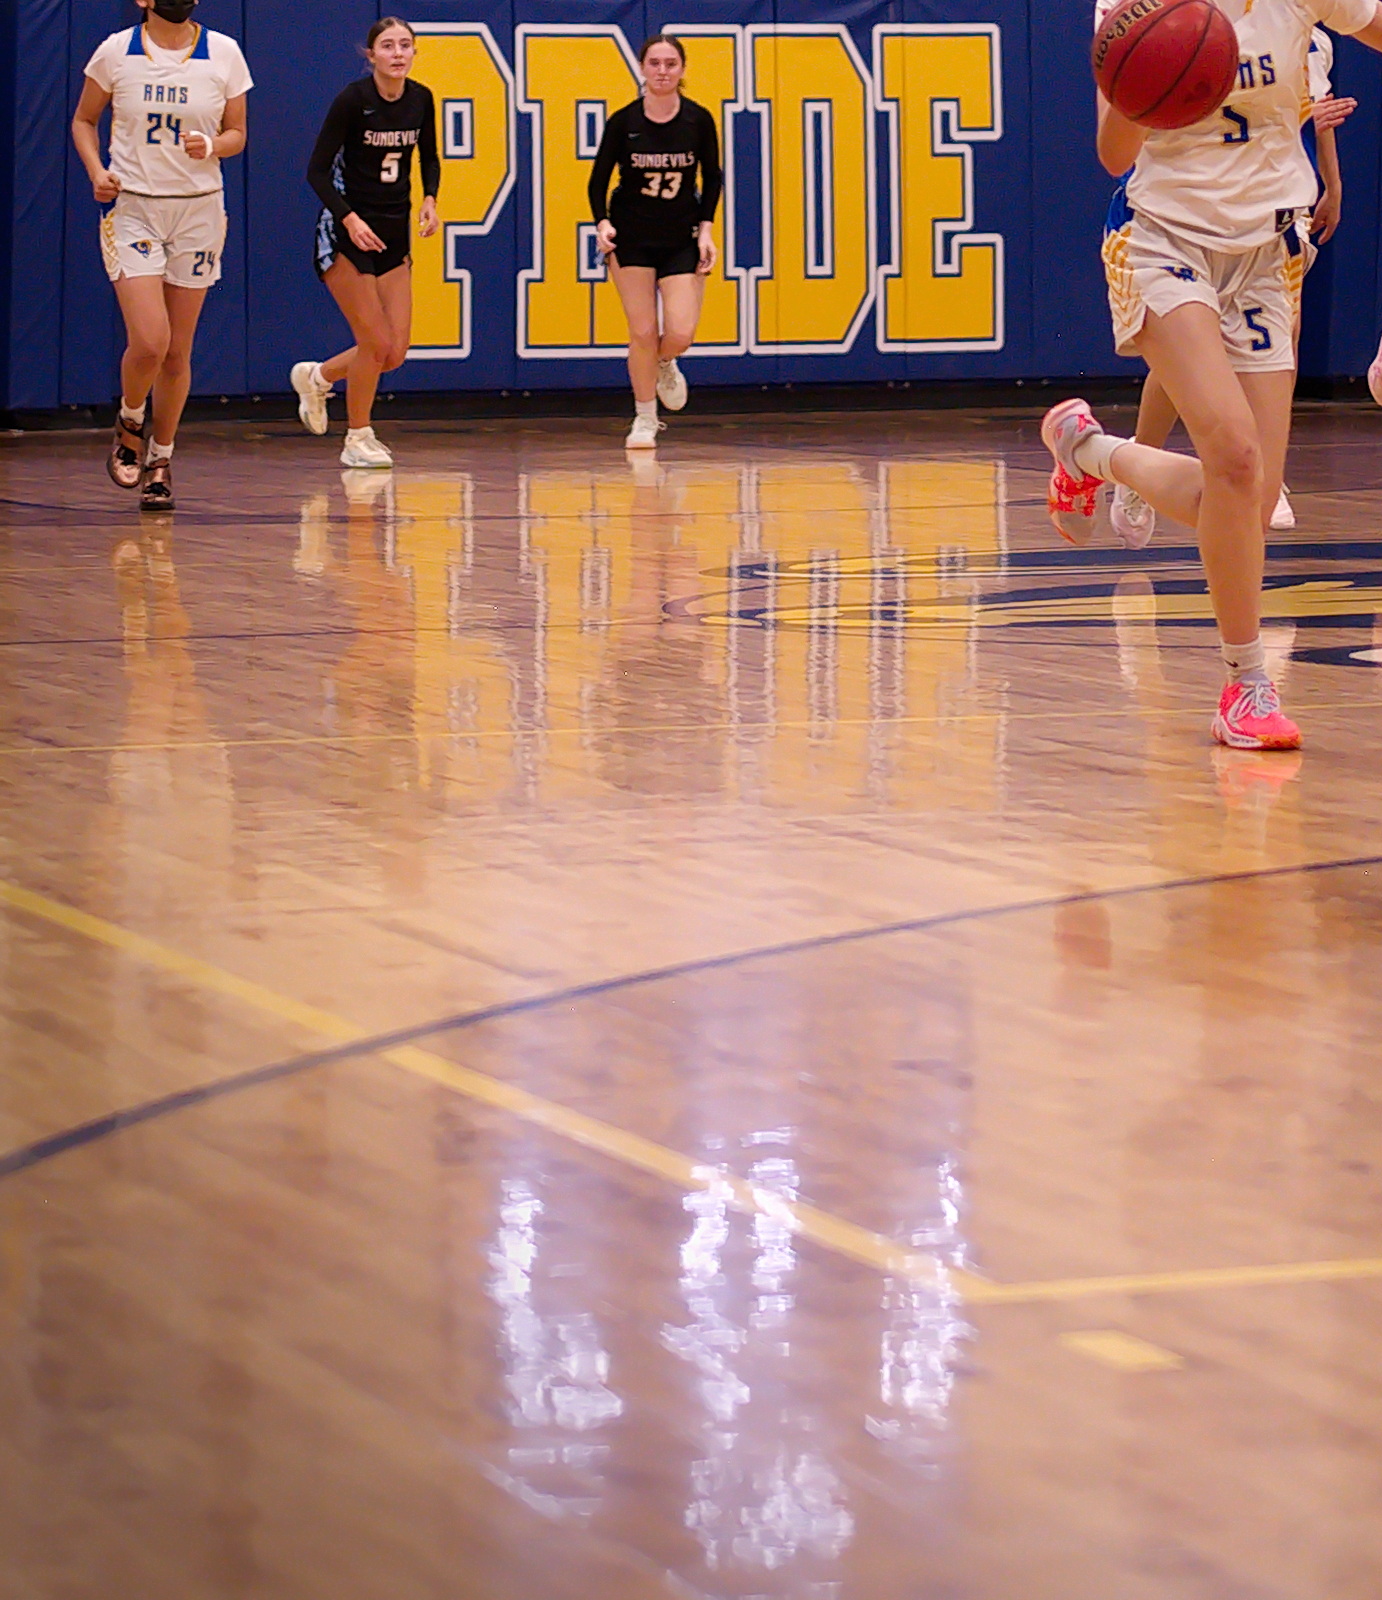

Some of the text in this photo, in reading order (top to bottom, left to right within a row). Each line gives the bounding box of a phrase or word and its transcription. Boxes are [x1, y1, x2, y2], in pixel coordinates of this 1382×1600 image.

[143, 83, 189, 104] RAMS
[146, 112, 182, 146] 24
[380, 152, 403, 183] 5
[630, 152, 695, 169] SUNDEVILS
[641, 171, 684, 200] 33
[191, 251, 216, 277] 24
[1243, 307, 1271, 351] 5
